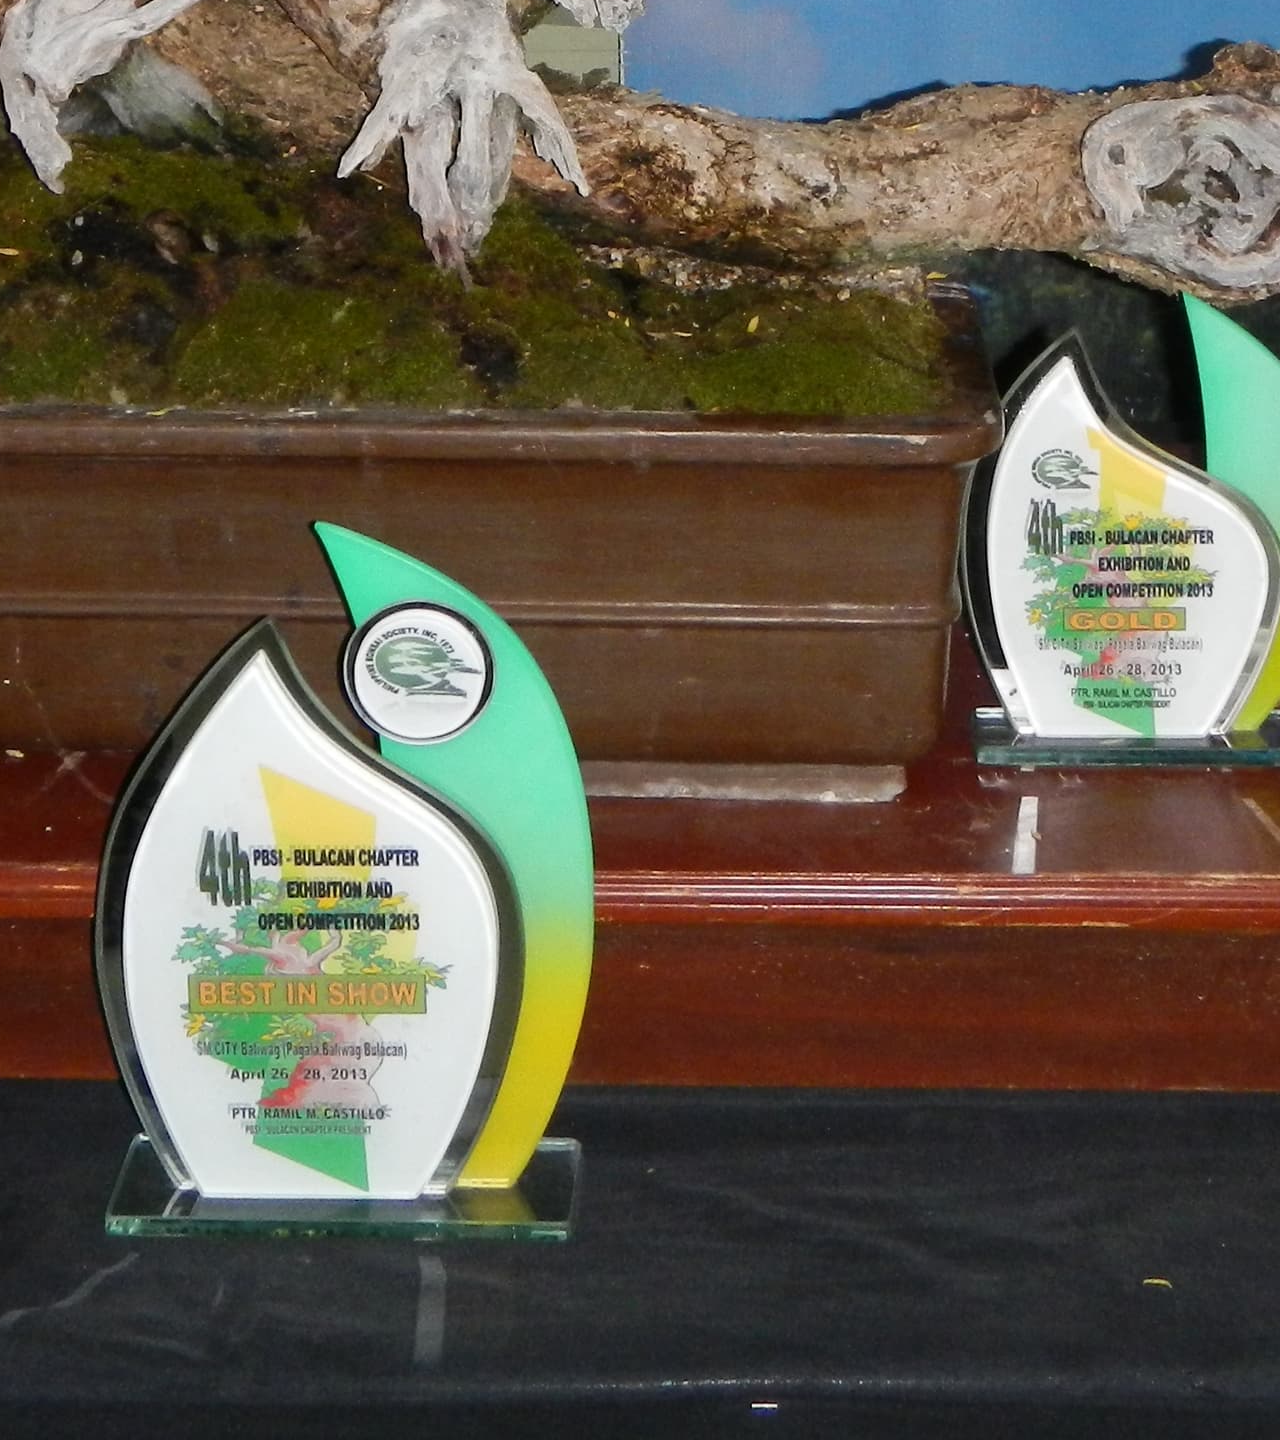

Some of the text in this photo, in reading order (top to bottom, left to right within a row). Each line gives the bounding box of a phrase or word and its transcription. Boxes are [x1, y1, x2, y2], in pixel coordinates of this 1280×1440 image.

[1027, 498, 1063, 555] 4th
[1070, 530, 1096, 545] PBSI
[1105, 530, 1158, 545] BULACAN
[1161, 530, 1214, 545] CHAPTER
[1098, 556, 1191, 572] EXHIBITION AND
[1072, 583, 1213, 598] OPEN COMPETITION 2013
[1070, 612, 1178, 630] GOLD
[1063, 663, 1094, 677] April
[1098, 663, 1115, 677] 26
[1127, 663, 1146, 677] 28,
[1151, 663, 1182, 677] 2013
[1093, 687, 1120, 698] RAMIL
[1133, 687, 1177, 698] CASTILLO
[253, 848, 282, 866] PBSI
[294, 848, 355, 866] BULACAN
[358, 848, 419, 866] CHAPTER
[198, 828, 252, 907] 4th
[286, 881, 393, 899] EXHIBITION AND
[258, 913, 420, 931] OPEN COMPETITION 2013
[198, 981, 418, 1006] BEST IN SHOW
[215, 1041, 237, 1056] CITY
[241, 1041, 280, 1059] Baliwag
[363, 1041, 407, 1059] Bulacan)
[230, 1068, 367, 1081] April 26 28, 2013
[264, 1107, 302, 1120] RAMIL
[306, 1107, 320, 1120] M.
[324, 1107, 385, 1120] CASTILLO
